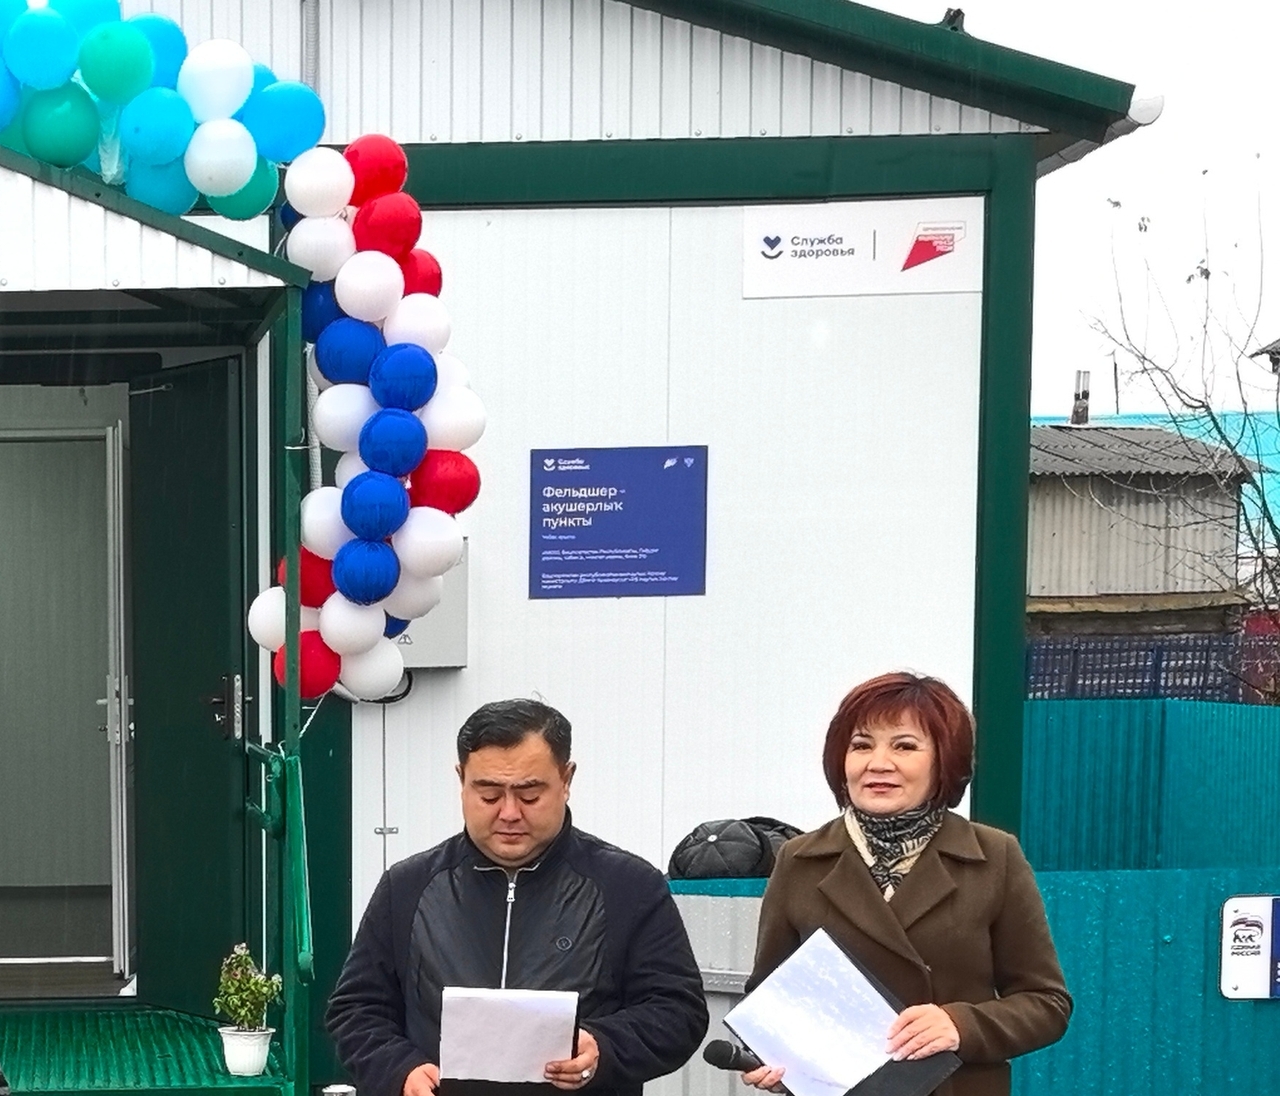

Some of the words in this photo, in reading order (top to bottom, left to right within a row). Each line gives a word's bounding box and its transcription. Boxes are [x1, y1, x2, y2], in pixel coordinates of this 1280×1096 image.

[791, 235, 843, 248] Служба
[791, 247, 855, 260] здоровья
[542, 516, 593, 530] пункты
